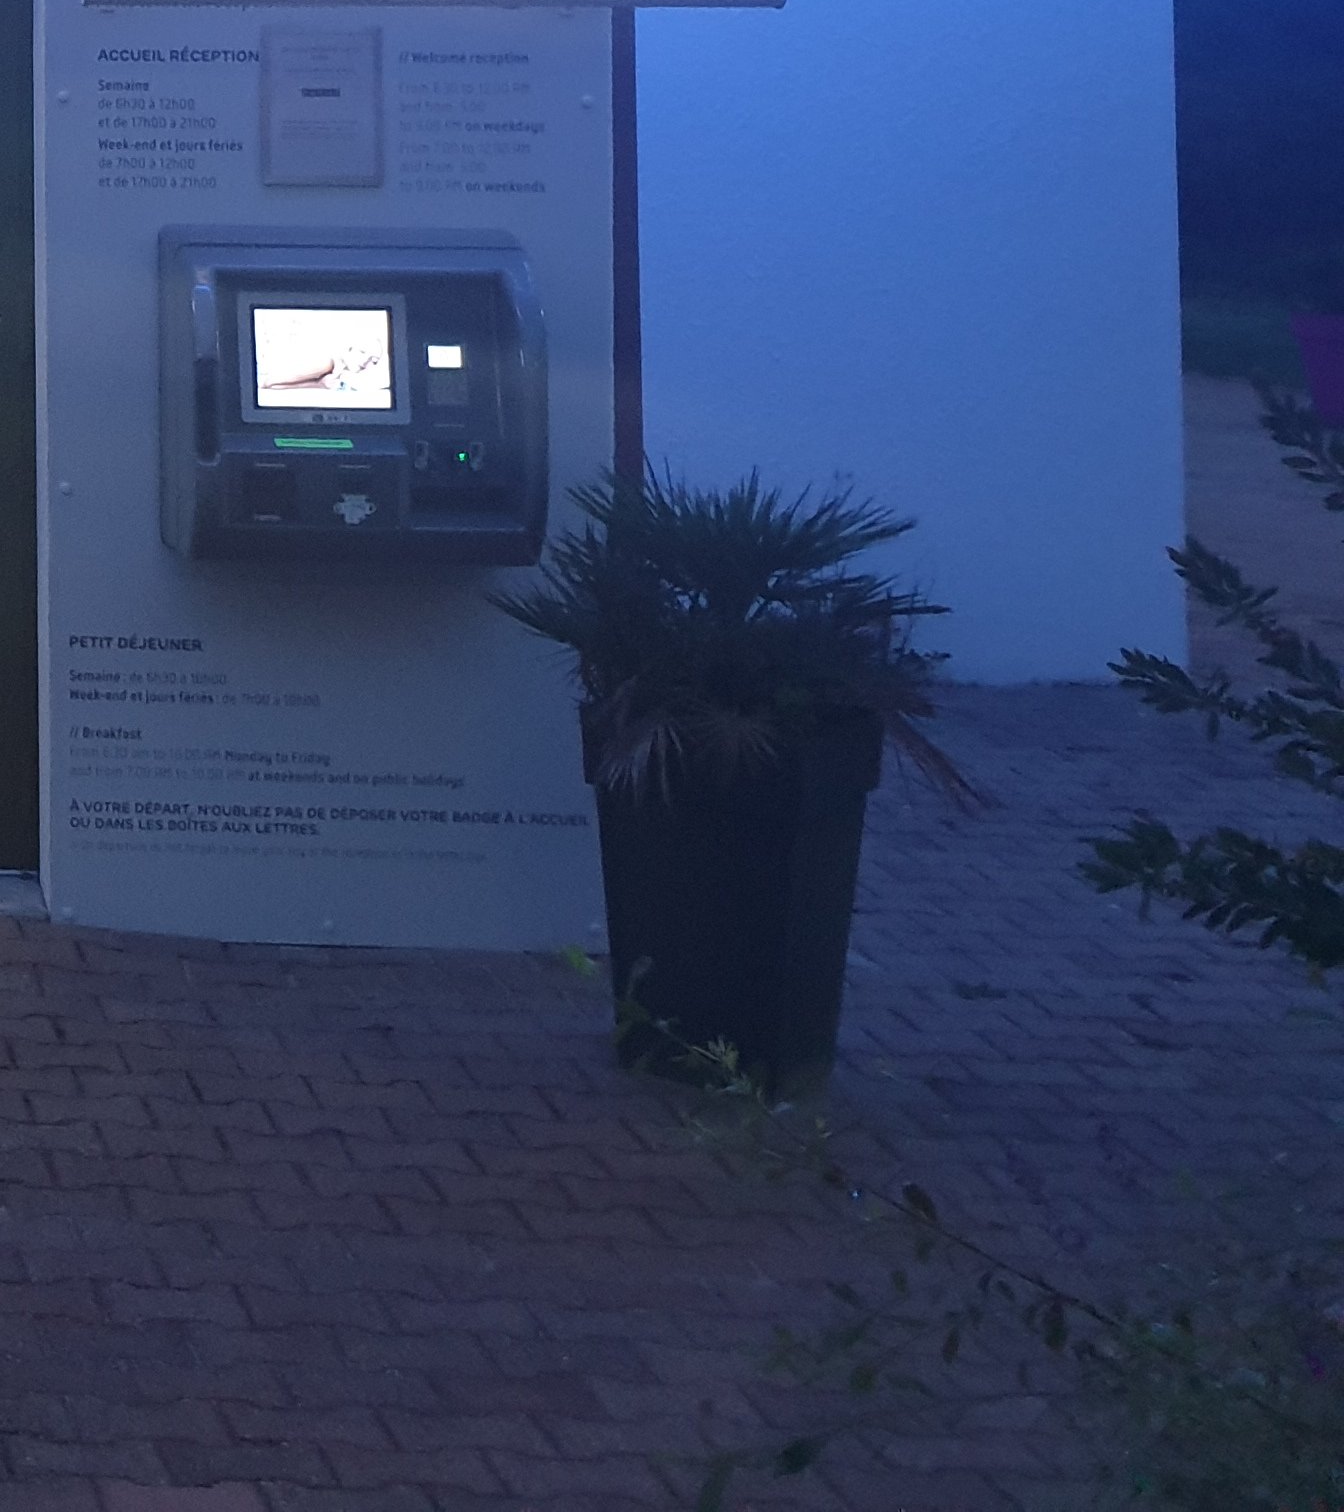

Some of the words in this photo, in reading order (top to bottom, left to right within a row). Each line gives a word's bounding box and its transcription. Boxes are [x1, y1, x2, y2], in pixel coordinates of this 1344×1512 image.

[98, 49, 165, 62] ACCUEIL
[169, 45, 260, 62] RÉCEPTION
[98, 79, 149, 91] Semaine
[98, 98, 112, 109] de
[98, 117, 110, 128] et
[113, 117, 127, 128] de
[98, 138, 156, 150] Week-end
[160, 140, 172, 150] et
[175, 139, 205, 153] jours
[98, 157, 112, 169] de
[98, 177, 110, 187] et
[114, 177, 128, 188] de
[70, 636, 113, 648] PETIT
[118, 632, 204, 651] DÉJEUNER
[69, 669, 120, 683] Semaine
[130, 690, 142, 701] et
[145, 690, 175, 704] jours
[82, 726, 142, 740] Breakfast
[84, 801, 130, 814] VOTRE
[276, 807, 303, 818] PAS
[307, 807, 326, 819] DE
[330, 807, 396, 820] DÉPOSER
[400, 810, 447, 823] VOTRE
[70, 817, 90, 828] OU
[95, 818, 133, 830] DANS
[138, 819, 163, 830] LES
[168, 816, 218, 832] BOÎTES
[222, 822, 250, 832] AUX
